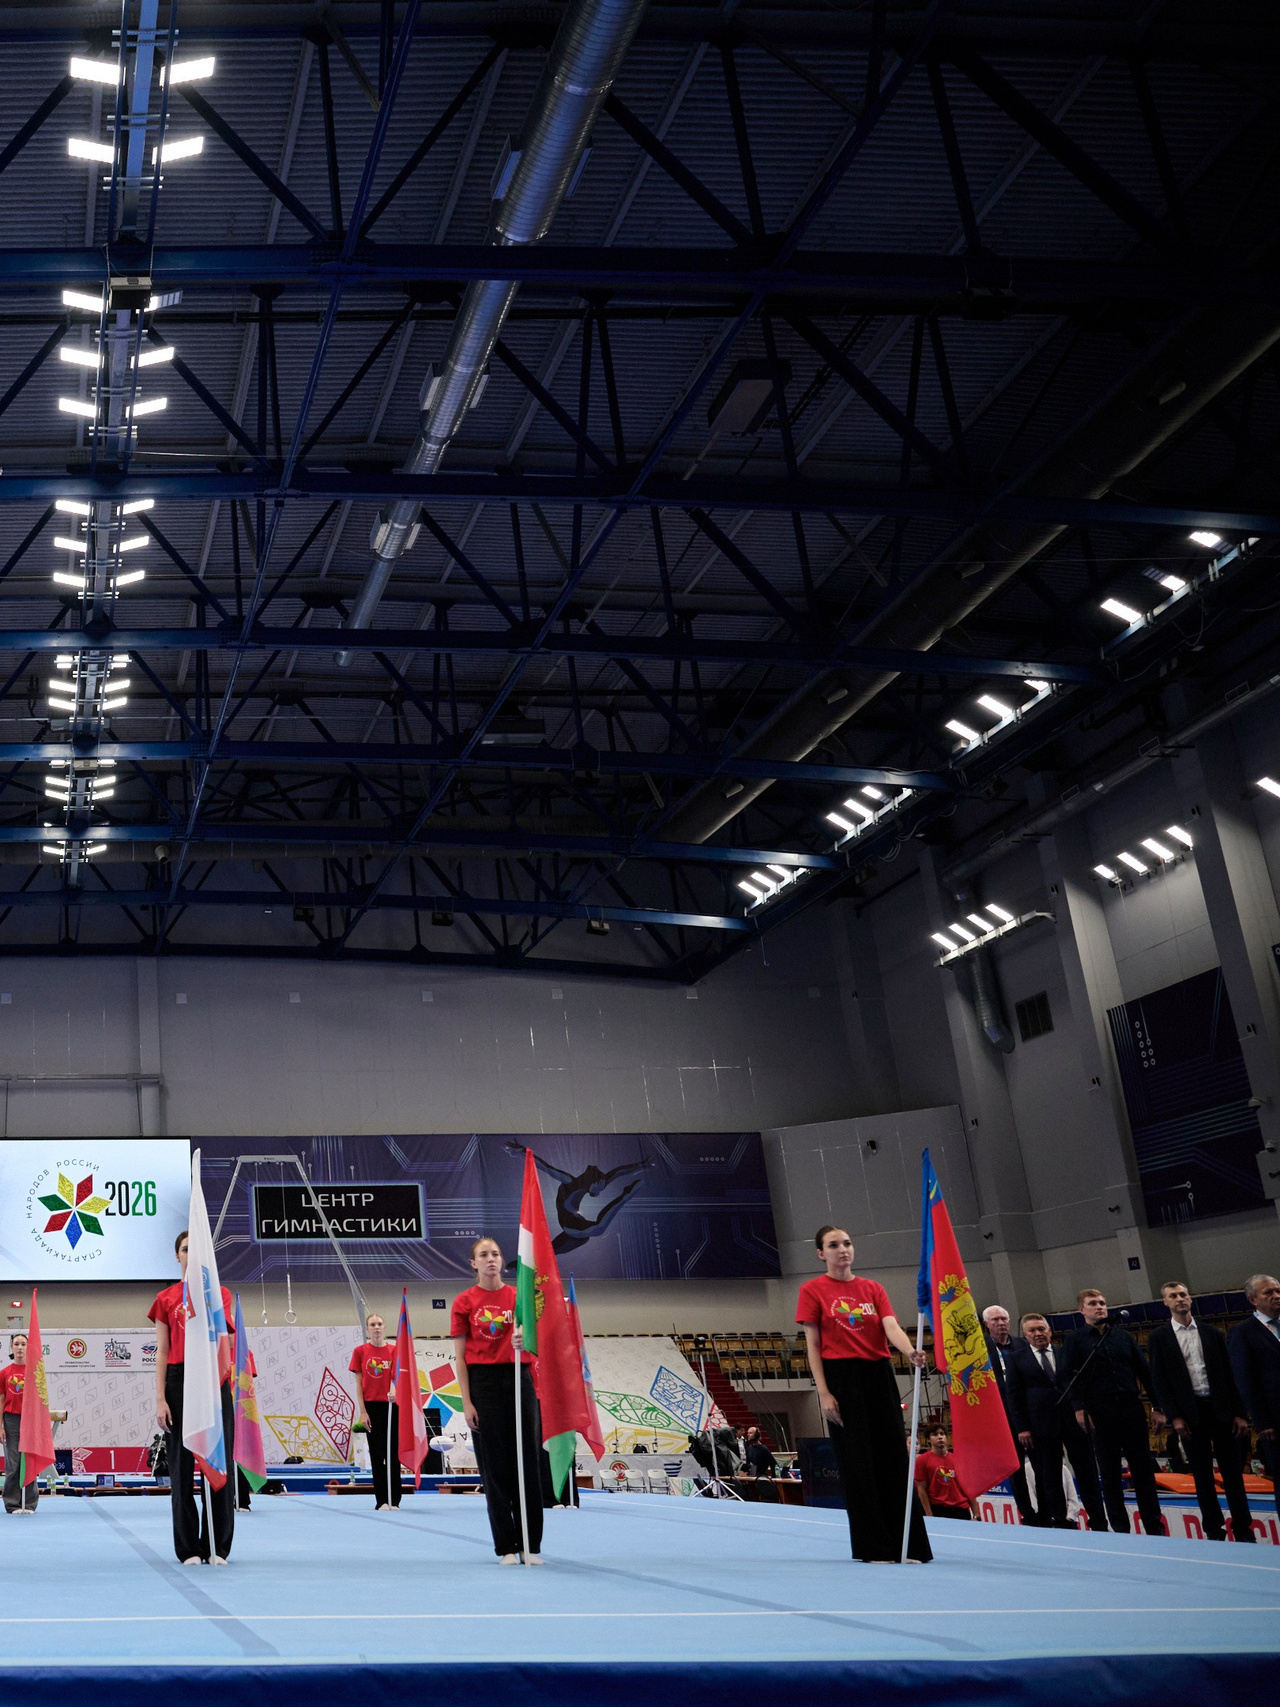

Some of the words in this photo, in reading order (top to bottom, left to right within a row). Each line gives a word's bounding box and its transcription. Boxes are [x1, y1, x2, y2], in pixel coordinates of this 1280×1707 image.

[56, 1158, 100, 1172] РОССИИ
[26, 1168, 50, 1219] НАРОДОВ
[104, 1180, 157, 1216] 2026
[301, 1192, 375, 1210] ЦЕНТР
[261, 1217, 418, 1233] ГИМНАСТИКИ
[31, 1227, 103, 1262] СПАРТАКИАДА
[41, 1344, 51, 1356] 26
[415, 1350, 457, 1361] ССИИ
